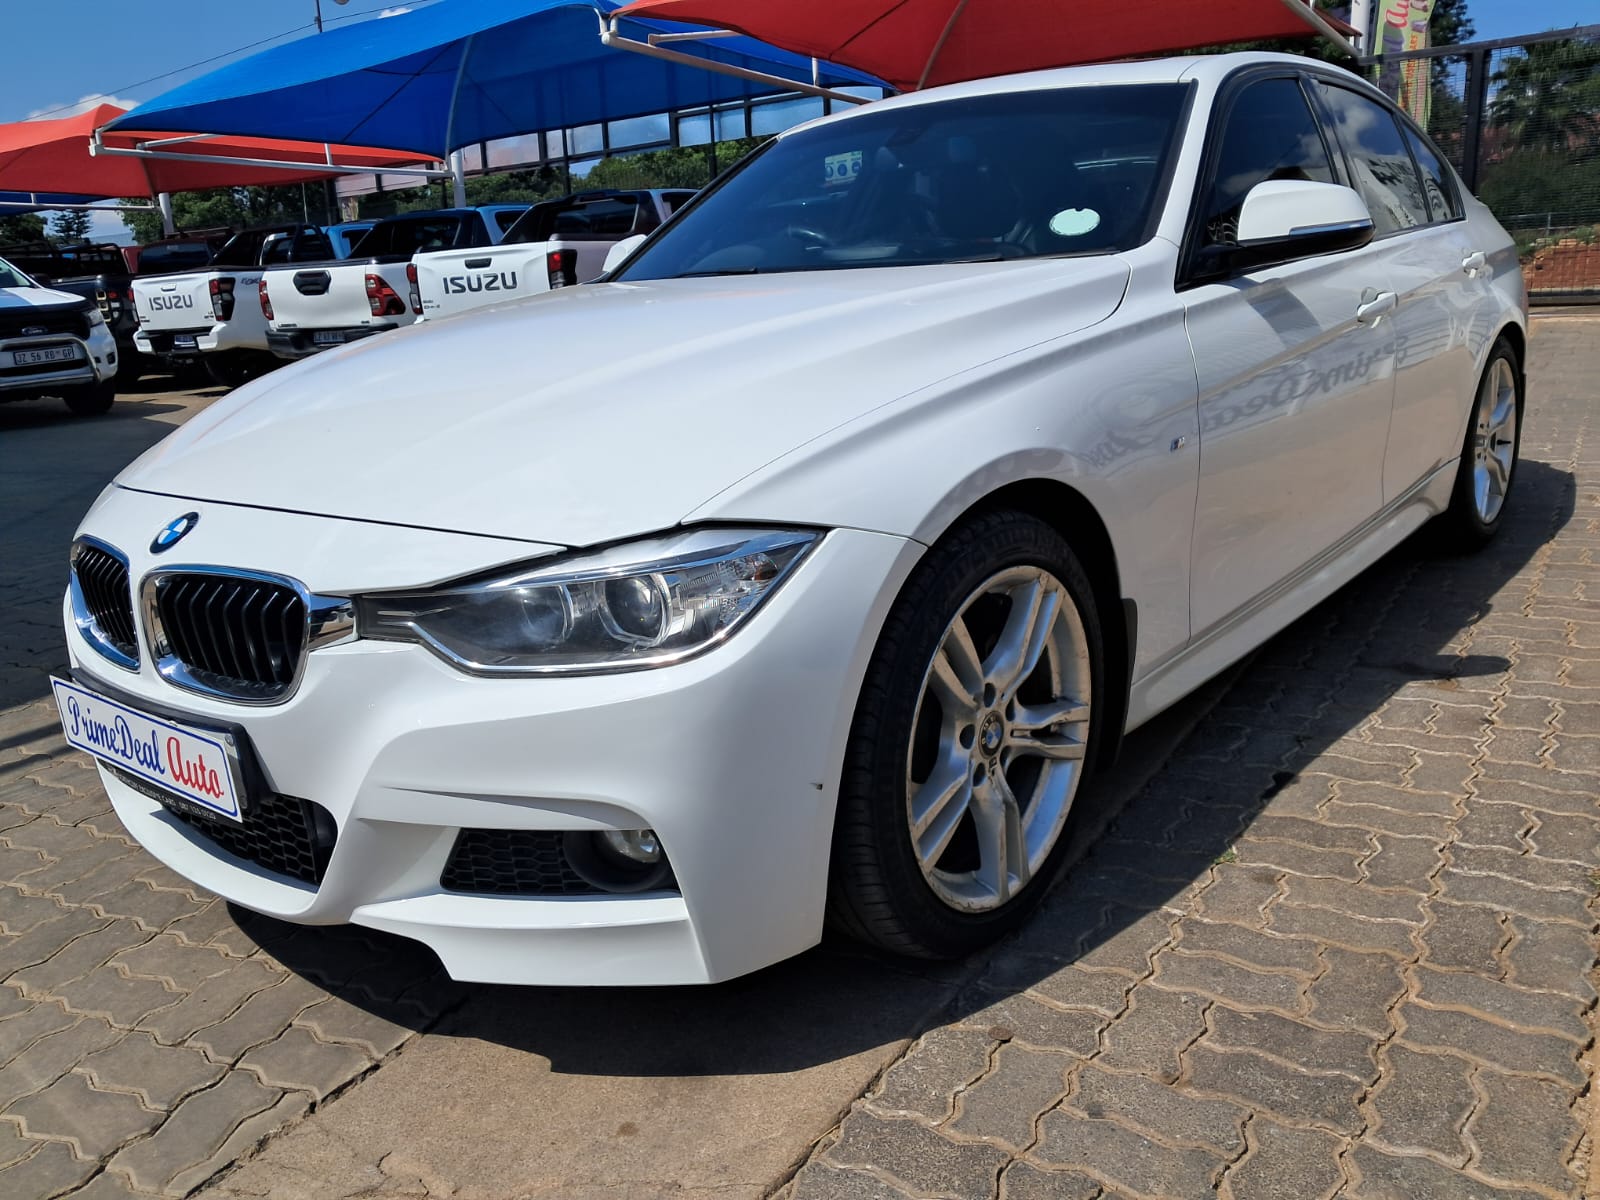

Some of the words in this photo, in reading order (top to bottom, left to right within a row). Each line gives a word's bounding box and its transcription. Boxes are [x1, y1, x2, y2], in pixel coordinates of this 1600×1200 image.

[443, 271, 517, 294] ISUZU
[149, 295, 193, 311] ISUZU
[67, 696, 165, 775] PrimeDeal
[166, 737, 225, 799] Auto
